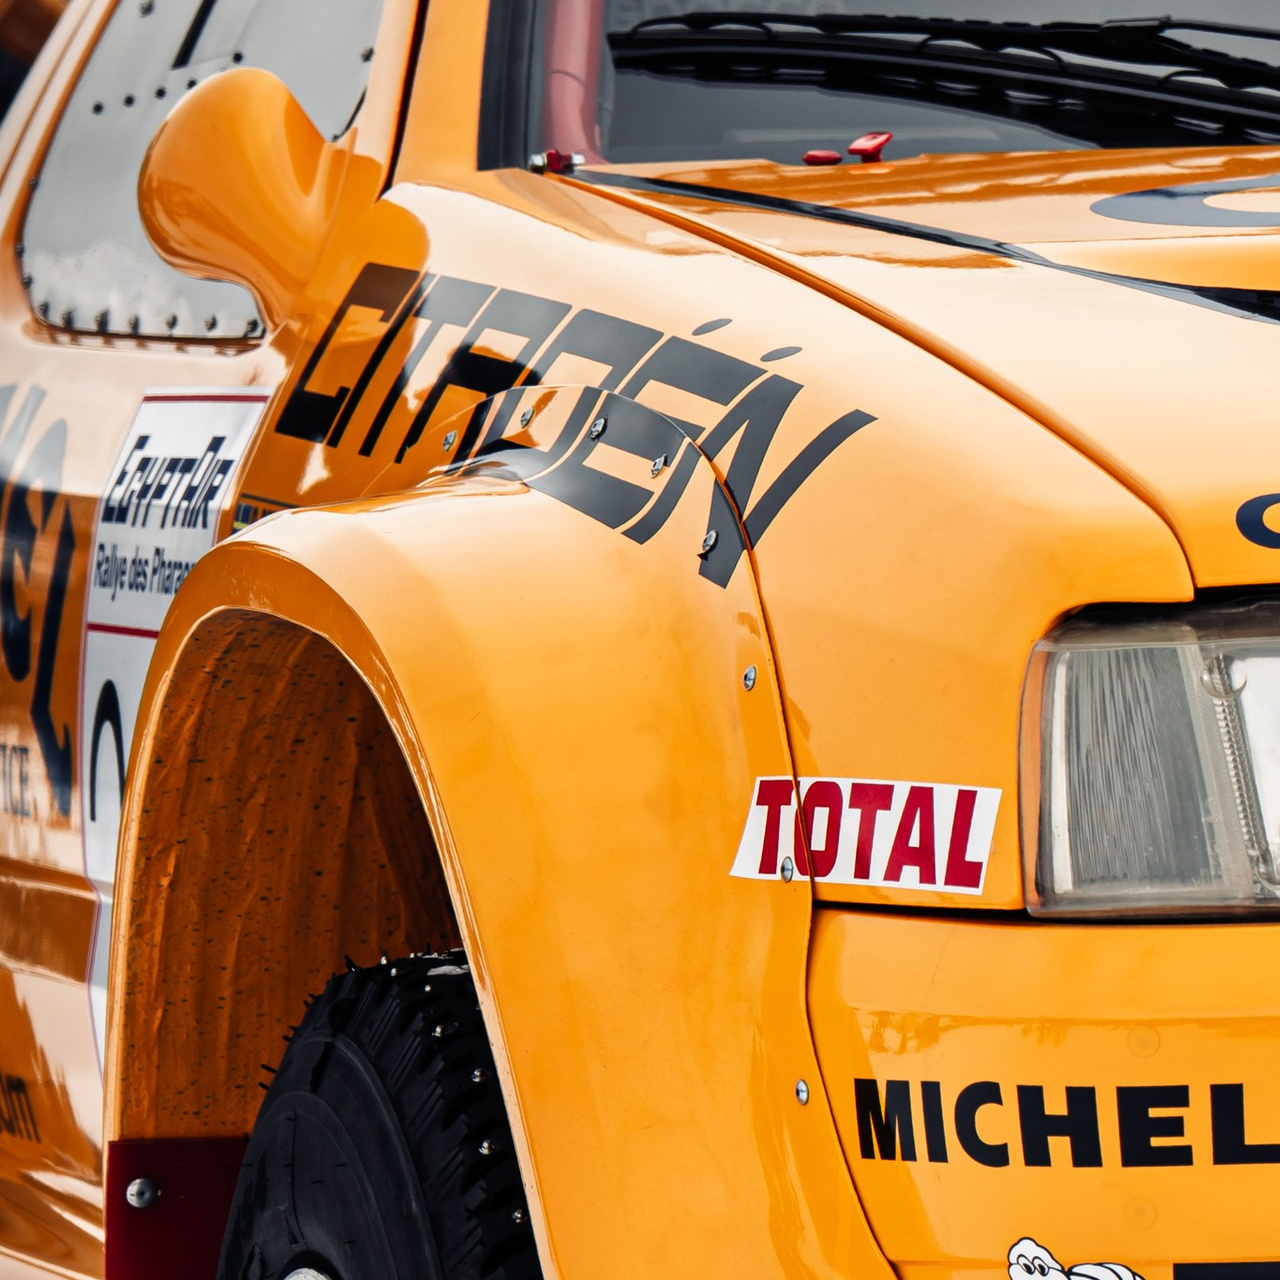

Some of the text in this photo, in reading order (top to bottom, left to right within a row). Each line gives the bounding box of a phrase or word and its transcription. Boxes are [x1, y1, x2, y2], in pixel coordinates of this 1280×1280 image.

[94, 543, 127, 602] Rallye
[129, 546, 148, 592] des
[755, 780, 983, 889] TOTAL
